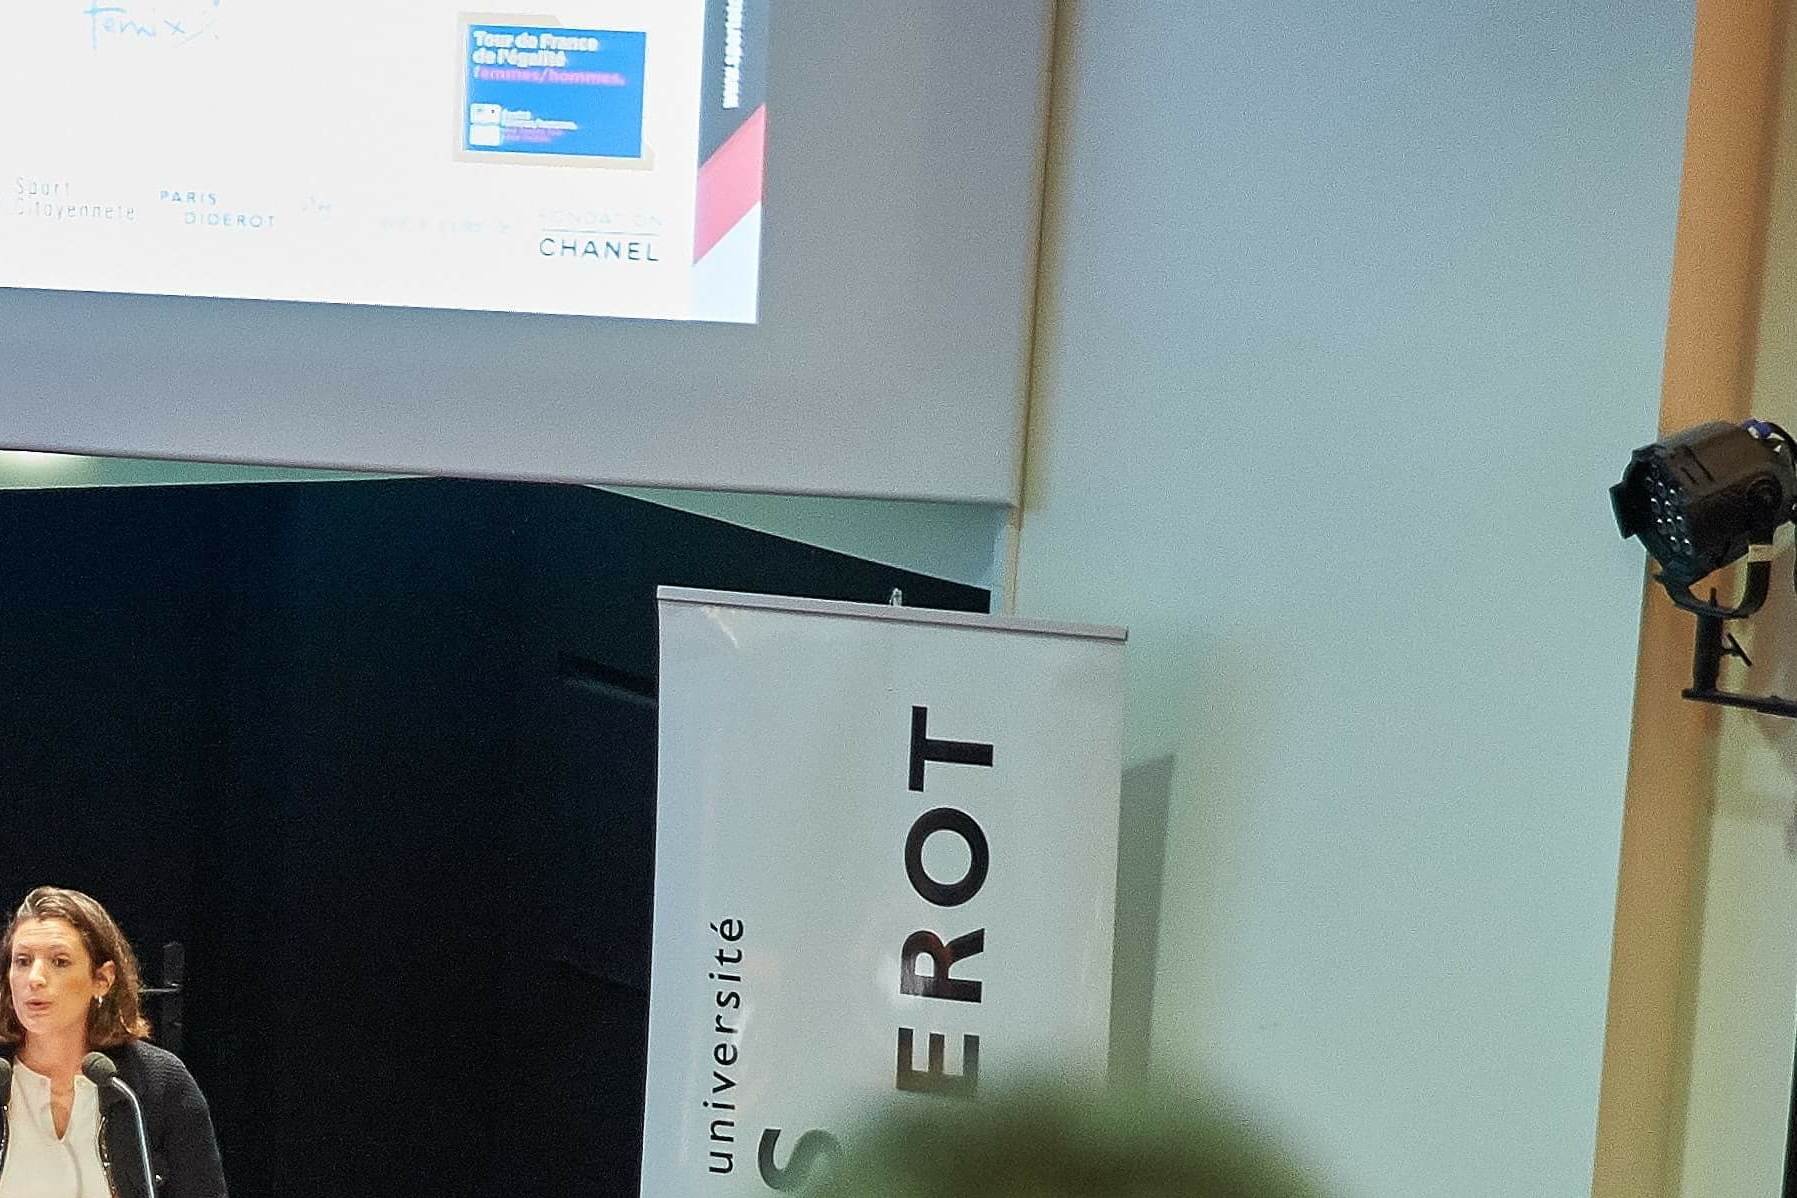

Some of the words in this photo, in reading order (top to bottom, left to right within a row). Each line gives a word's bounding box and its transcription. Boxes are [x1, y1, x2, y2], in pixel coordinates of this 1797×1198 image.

[159, 190, 218, 207] PARIS
[184, 210, 277, 229] DIDEROT
[539, 237, 660, 262] CHANEL
[894, 705, 995, 1093] EROT
[703, 915, 745, 1175] université
